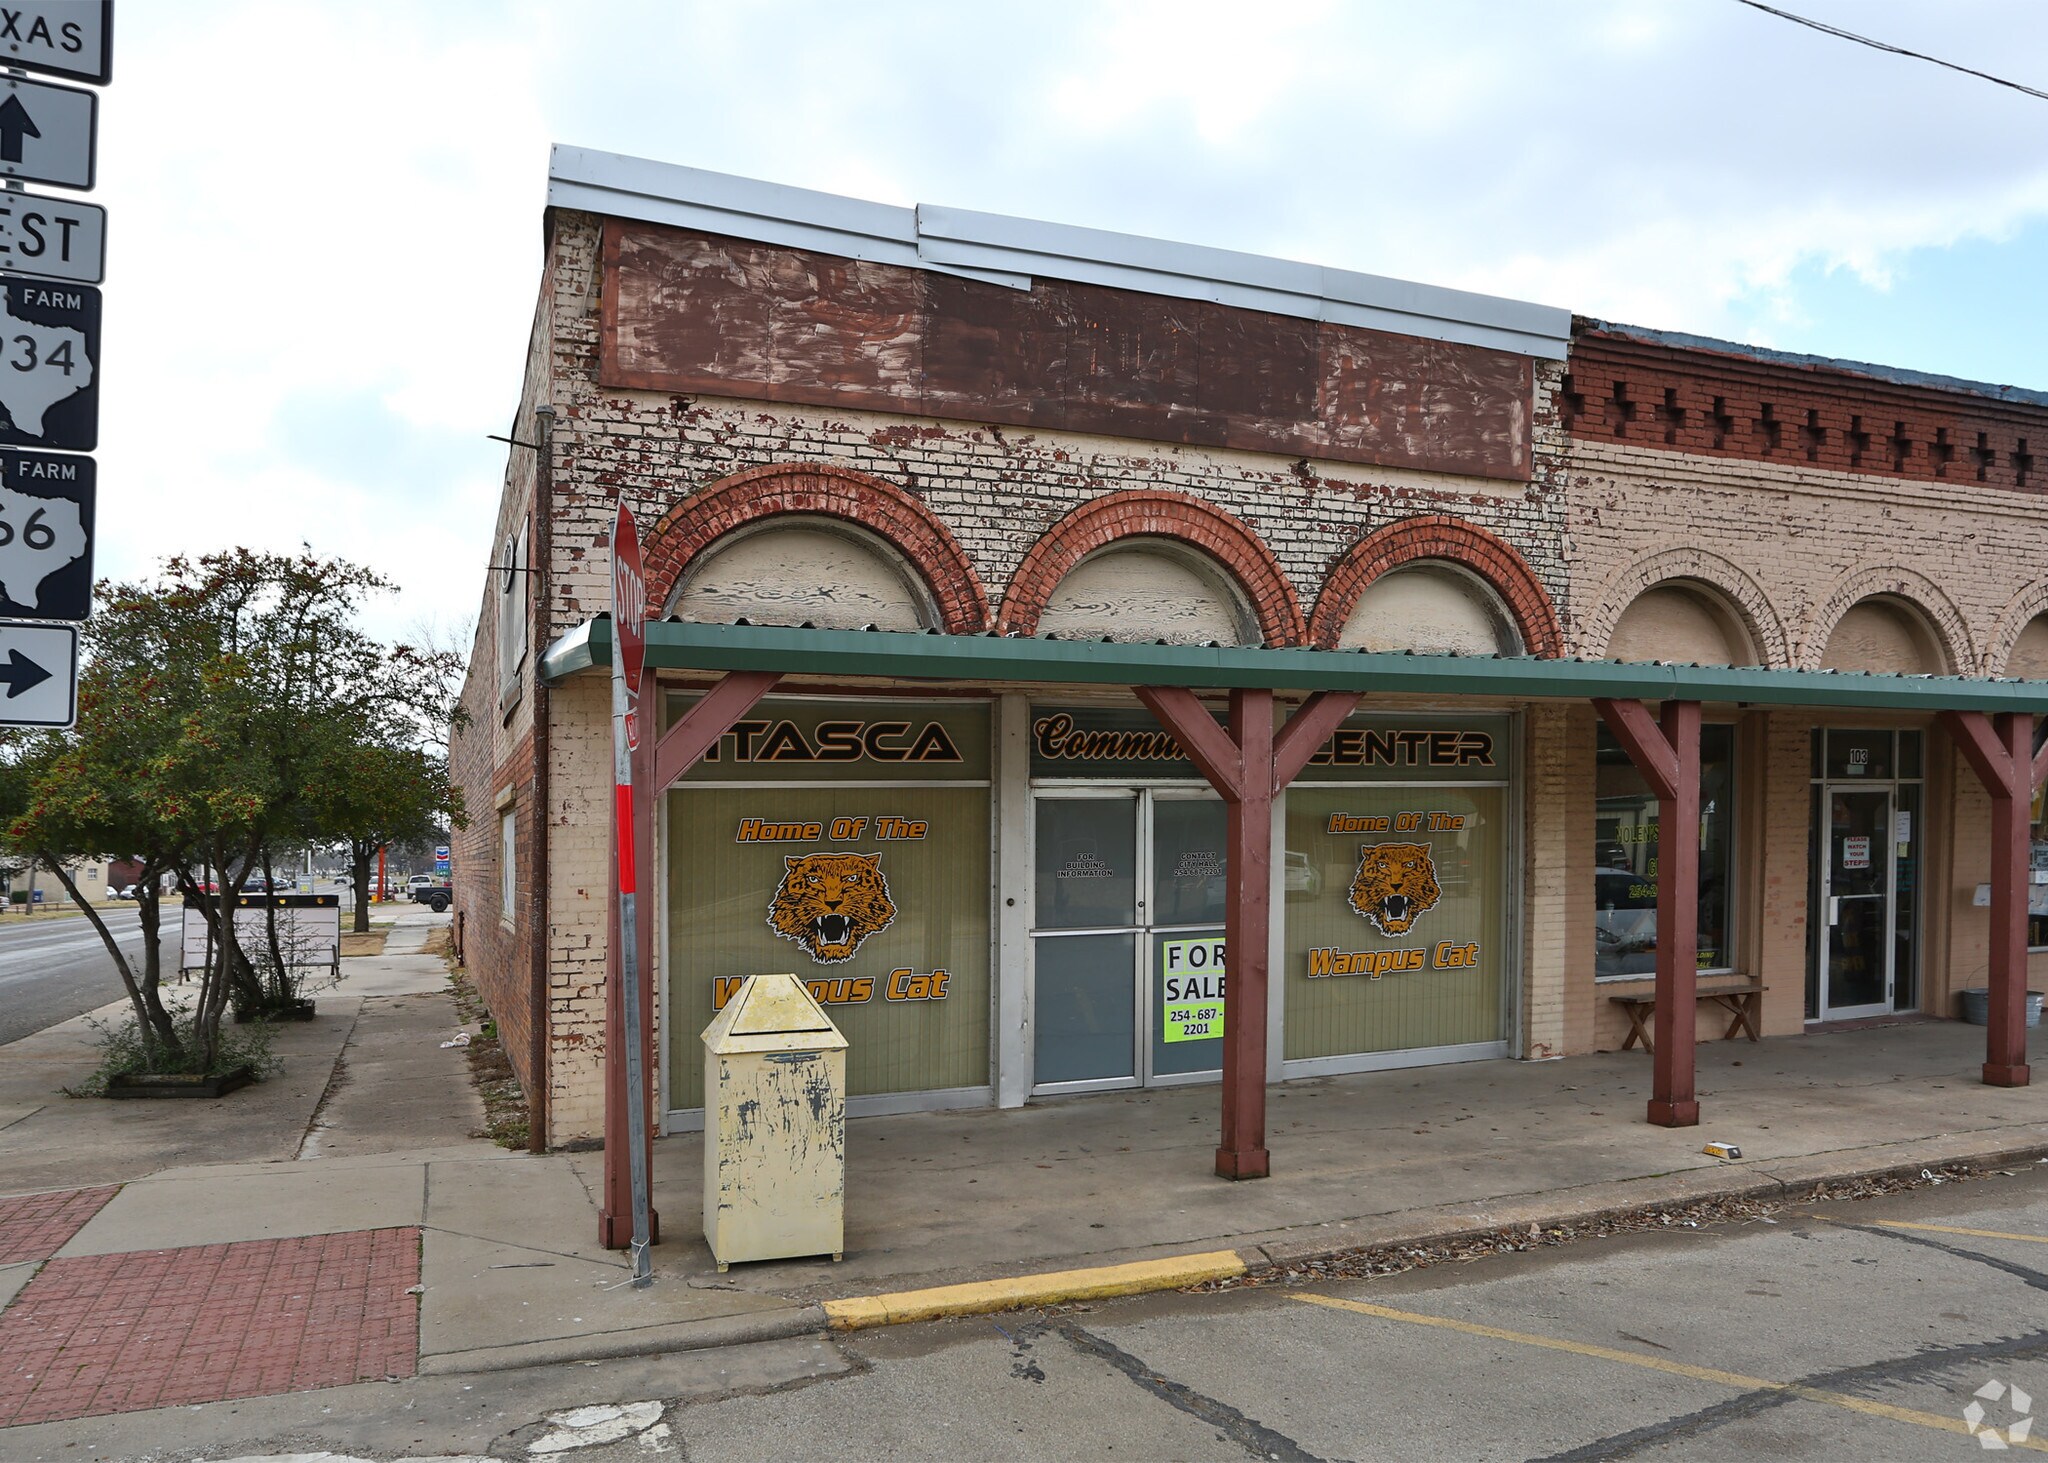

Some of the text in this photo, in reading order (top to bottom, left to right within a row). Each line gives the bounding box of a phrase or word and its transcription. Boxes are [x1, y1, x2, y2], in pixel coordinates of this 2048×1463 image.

[24, 289, 81, 310] FARM
[0, 335, 75, 376] 34
[19, 461, 76, 480] FARM
[617, 555, 643, 639] STOP
[1034, 713, 1190, 761] Commu
[1850, 749, 1868, 765] 103
[736, 816, 928, 843] Home Of The
[1328, 811, 1466, 834] Home Of The
[1066, 861, 1105, 869] BUILDING
[1077, 853, 1095, 861] FOR
[1179, 860, 1218, 868] CITY HALL
[1180, 852, 1217, 860] CONTACT
[1057, 869, 1113, 878] INFORMATION
[1169, 944, 1225, 969] FOR
[1308, 940, 1480, 980] Wampus Cat
[885, 967, 951, 1002] Cat
[1166, 976, 1225, 1001] SALE
[1183, 1023, 1209, 1035] 2201
